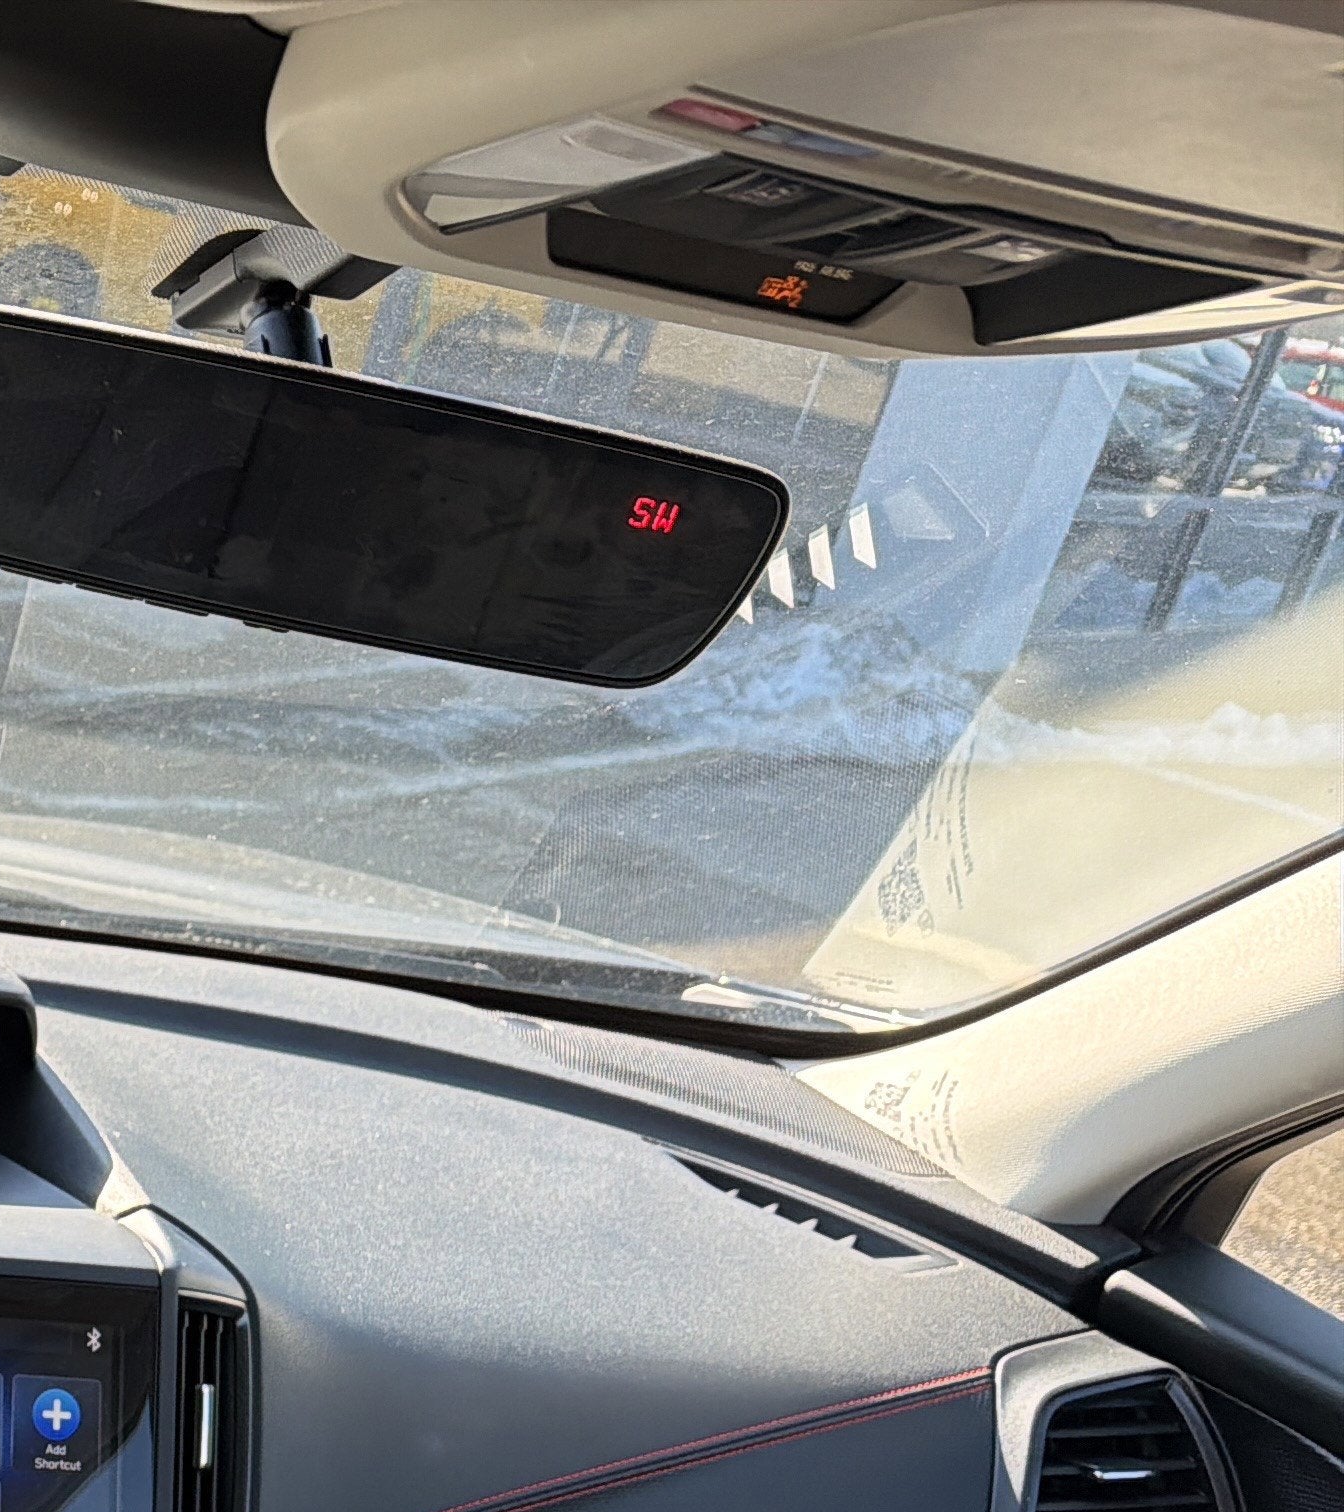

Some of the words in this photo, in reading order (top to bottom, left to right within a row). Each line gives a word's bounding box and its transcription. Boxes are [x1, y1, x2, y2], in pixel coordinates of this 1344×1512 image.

[626, 494, 680, 537] SW
[45, 1444, 67, 1457] Add
[33, 1456, 81, 1472] Shortcut
